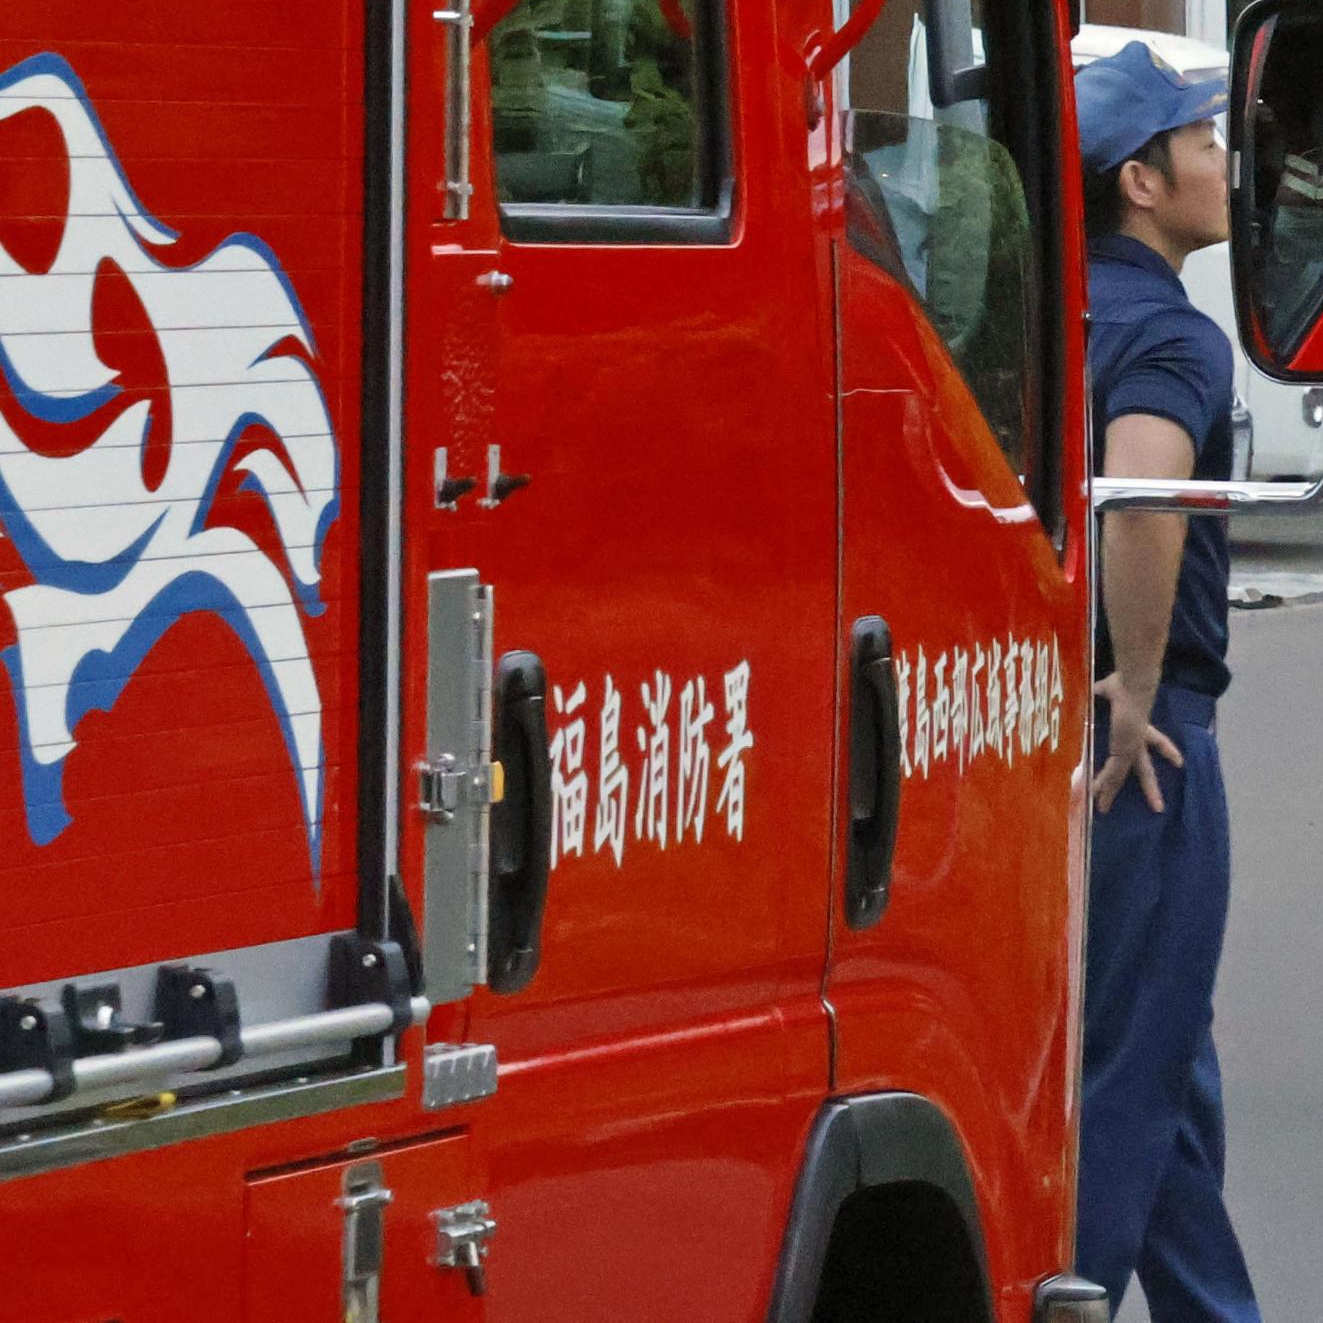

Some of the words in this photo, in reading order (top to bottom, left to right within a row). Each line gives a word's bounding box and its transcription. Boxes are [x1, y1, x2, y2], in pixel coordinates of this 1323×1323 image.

[549, 658, 754, 871] 福島消防署
